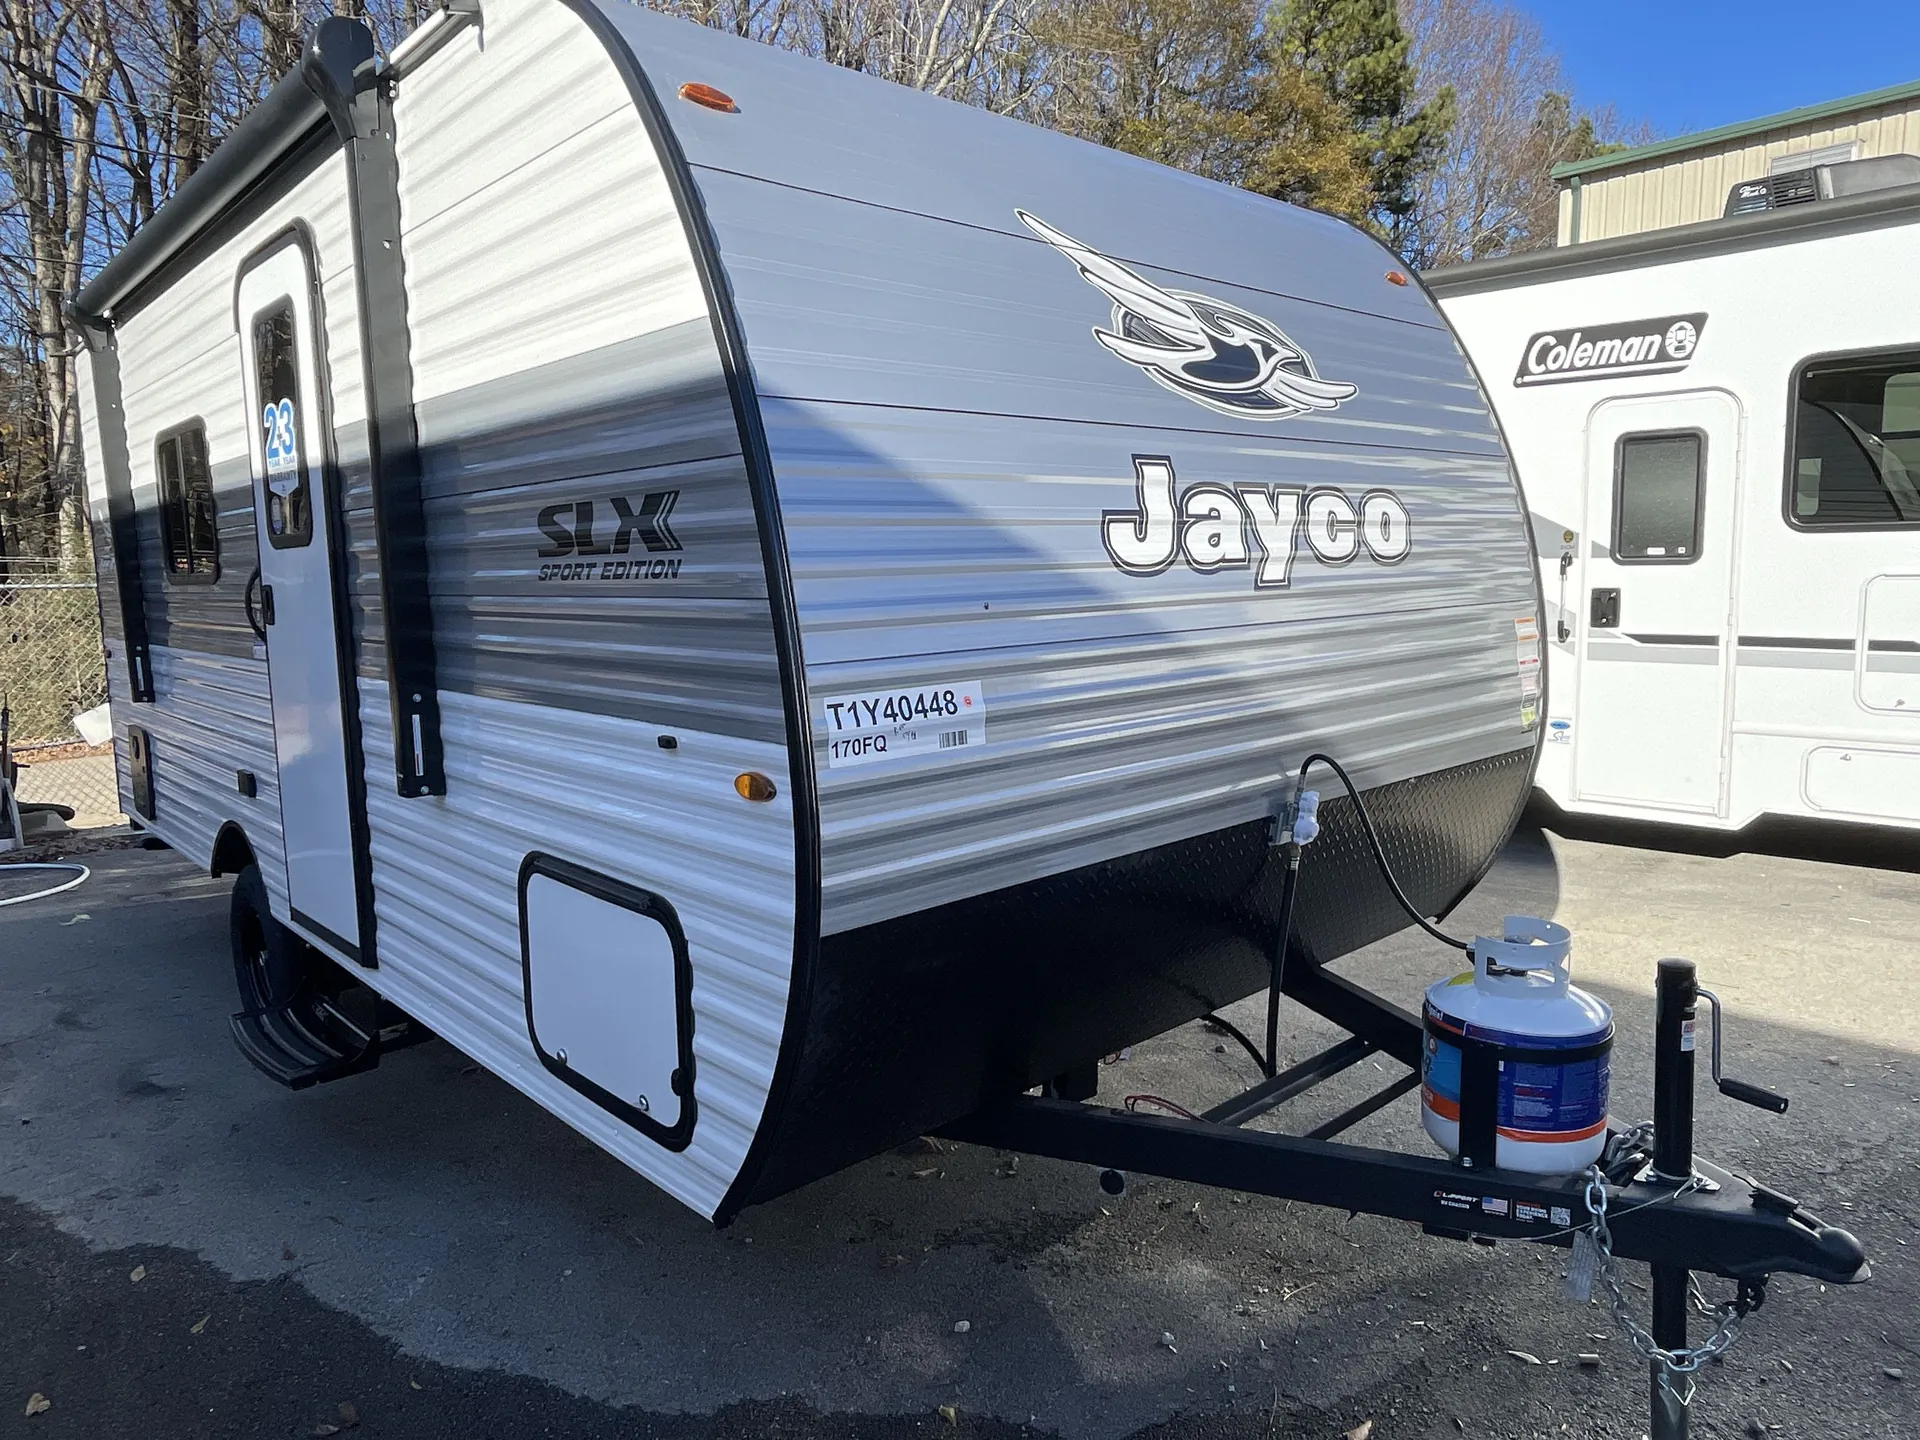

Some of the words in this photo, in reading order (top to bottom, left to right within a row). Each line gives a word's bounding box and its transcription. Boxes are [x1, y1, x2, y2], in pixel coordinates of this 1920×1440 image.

[1528, 332, 1662, 374] Coleman
[537, 490, 683, 557] SLX
[1101, 453, 1412, 591] Jayco
[538, 562, 597, 581] SPORT
[600, 559, 682, 580] EDITION
[826, 690, 958, 730] T1Y40448
[831, 734, 887, 759] 170FQ
